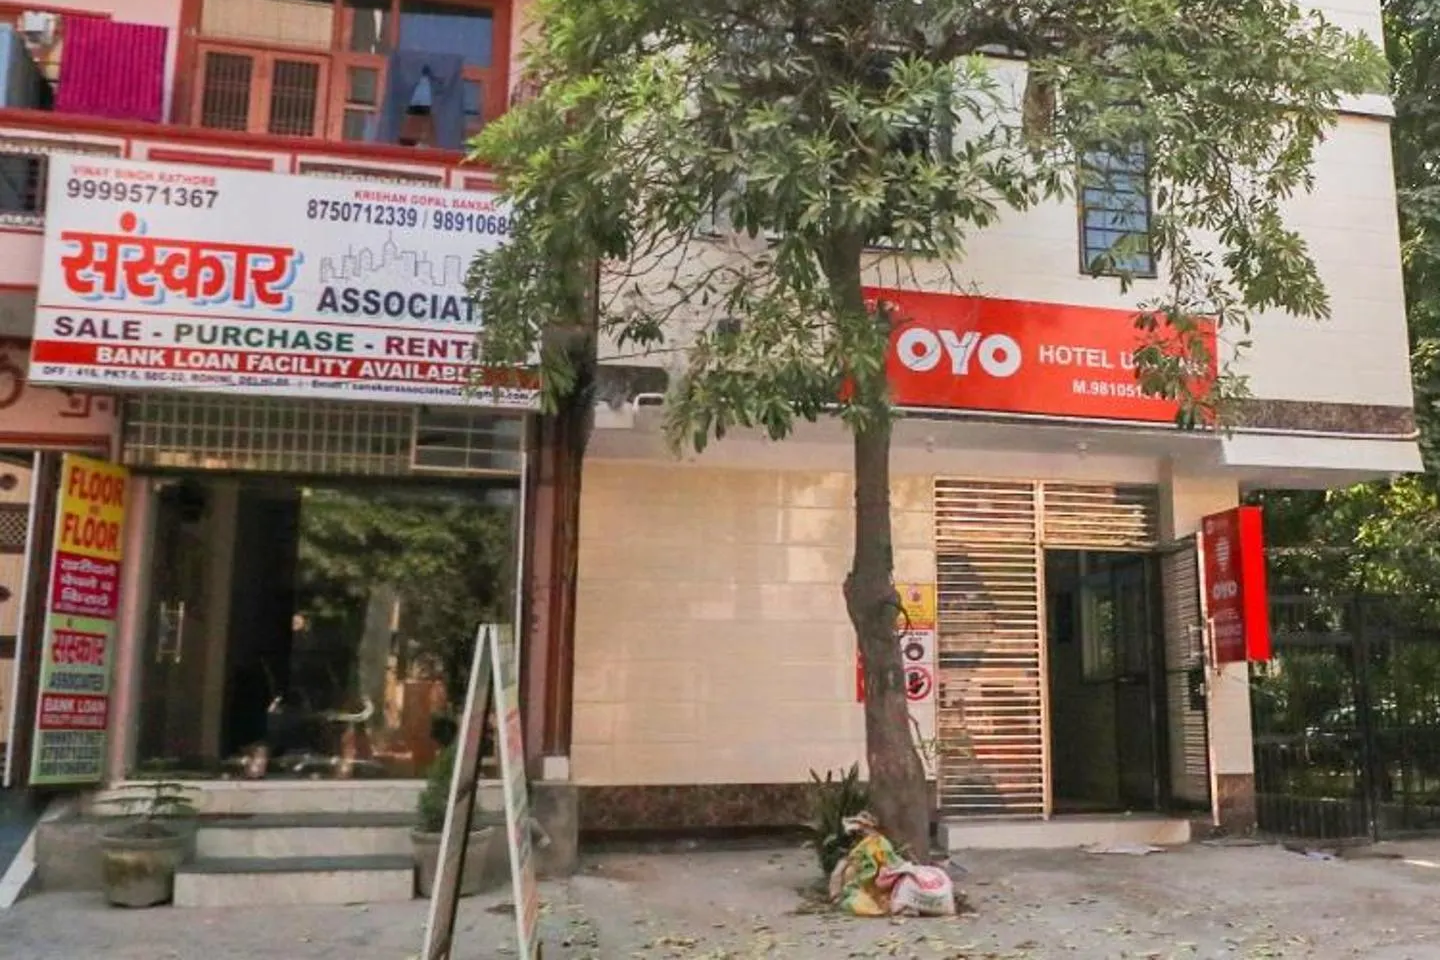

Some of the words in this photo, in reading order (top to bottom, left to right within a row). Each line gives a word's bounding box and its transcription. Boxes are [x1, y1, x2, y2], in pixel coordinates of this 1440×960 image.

[66, 178, 219, 209] 9999571367
[411, 196, 447, 208] GOPAL
[307, 199, 417, 227] 8750712339
[60, 211, 298, 308] संस्कार
[317, 286, 479, 322] ASSOCIAT
[53, 316, 141, 340] SALE
[174, 323, 354, 352] PURCHASE
[897, 327, 1022, 377] OYO
[96, 347, 166, 366] BANK
[173, 351, 239, 370] LOAN
[247, 353, 354, 375] FACILITY
[1039, 345, 1115, 370] HOTEL
[69, 465, 124, 508] FLOOR
[61, 512, 119, 553] FLOOR
